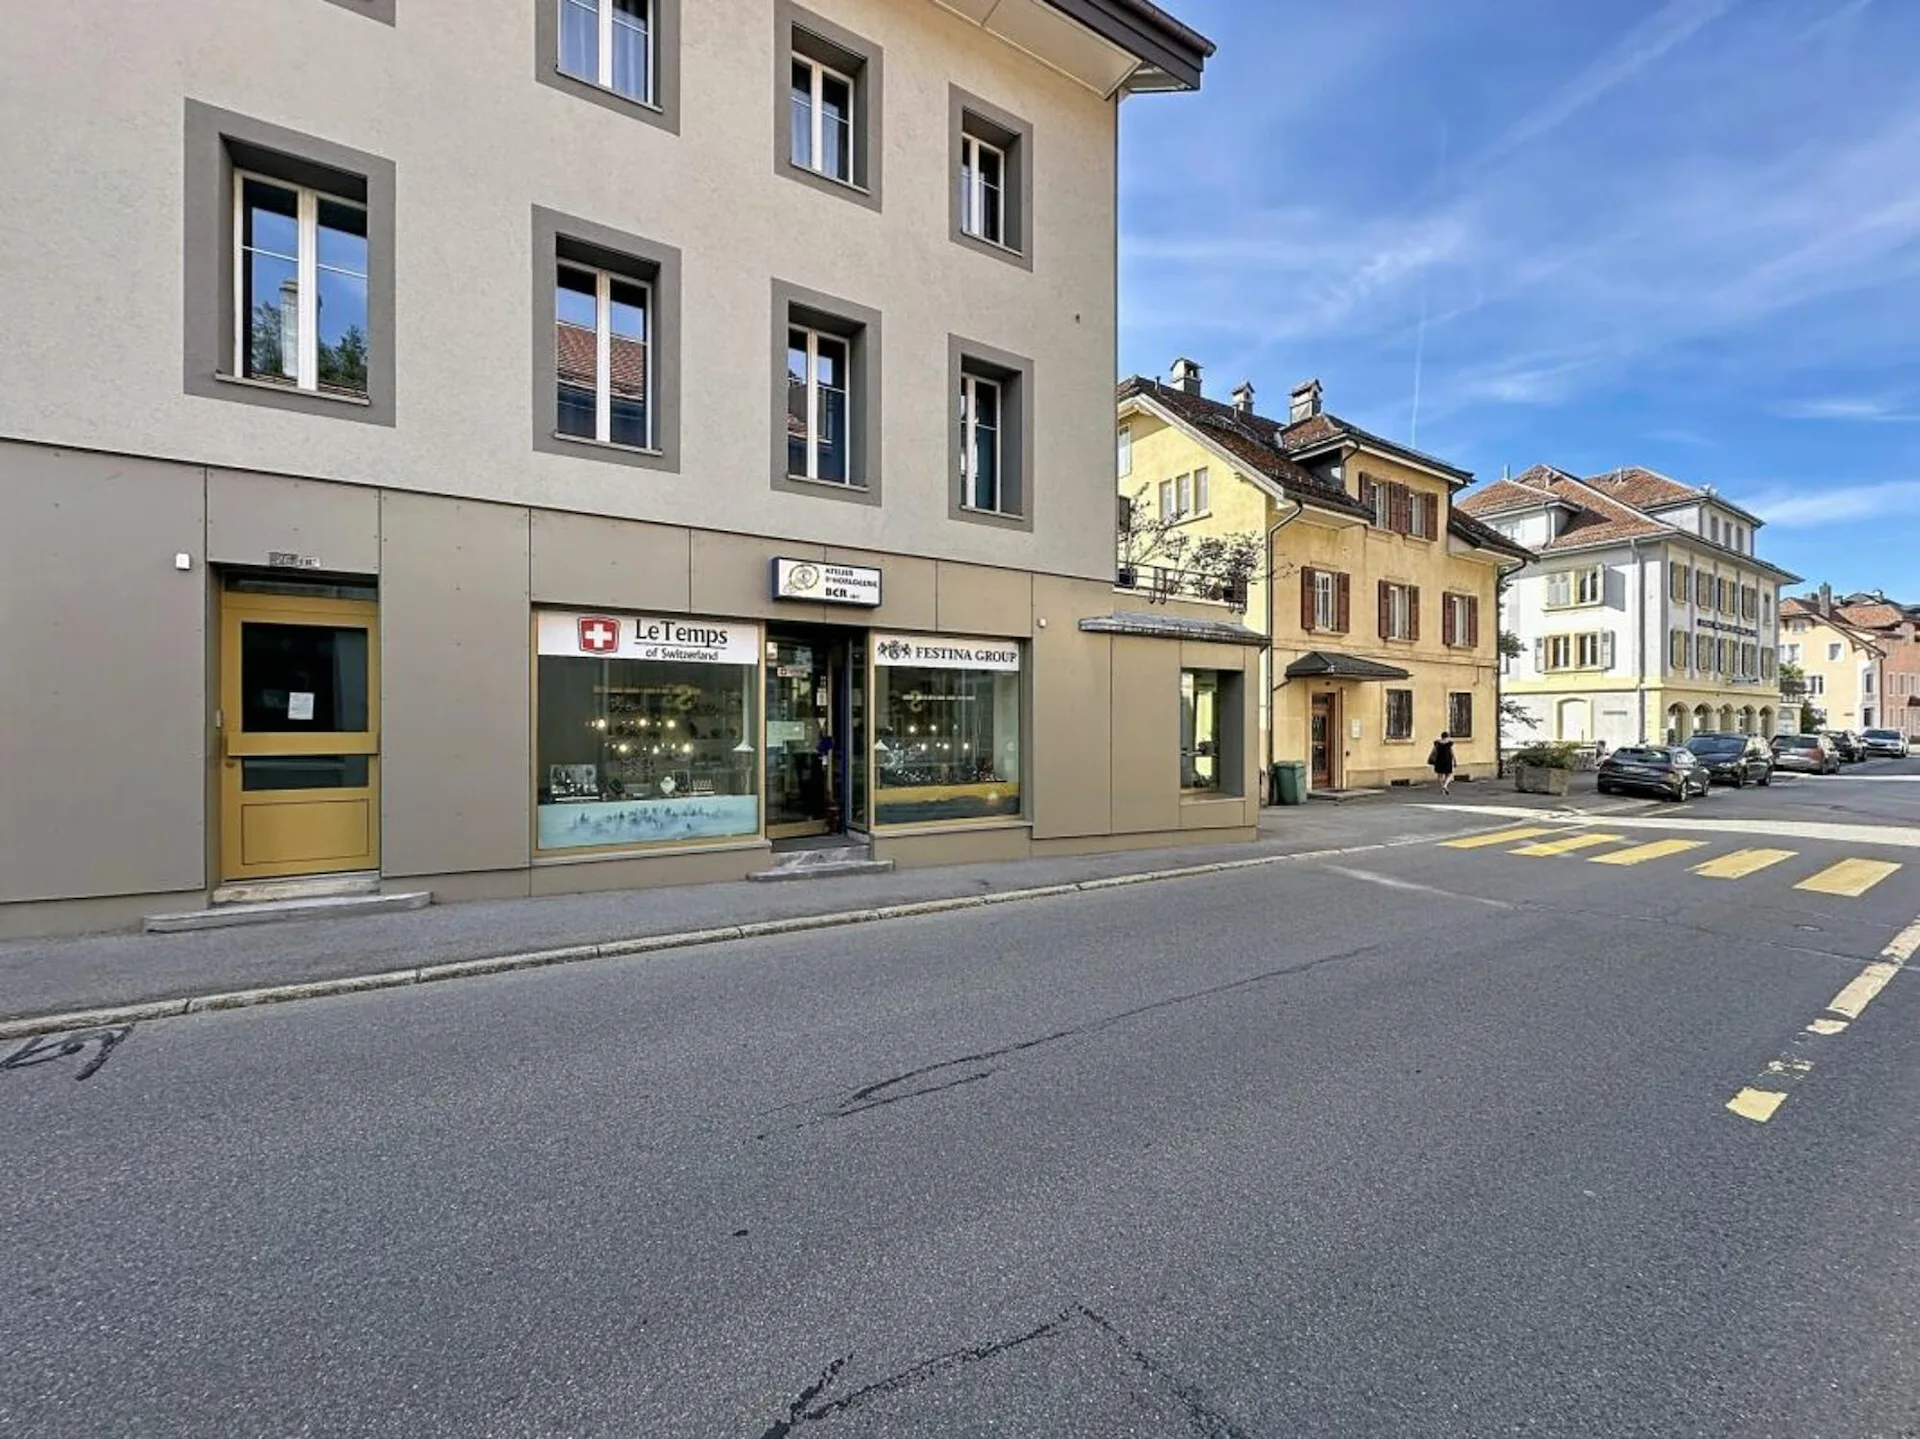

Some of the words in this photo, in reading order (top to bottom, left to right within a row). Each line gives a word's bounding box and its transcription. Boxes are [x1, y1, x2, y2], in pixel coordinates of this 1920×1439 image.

[825, 568, 854, 577] ATELIER
[825, 587, 848, 598] BCR
[645, 648, 658, 658] of
[661, 648, 719, 661] Switzerland
[916, 646, 972, 661] FESTINA
[975, 650, 1017, 663] GROUP
